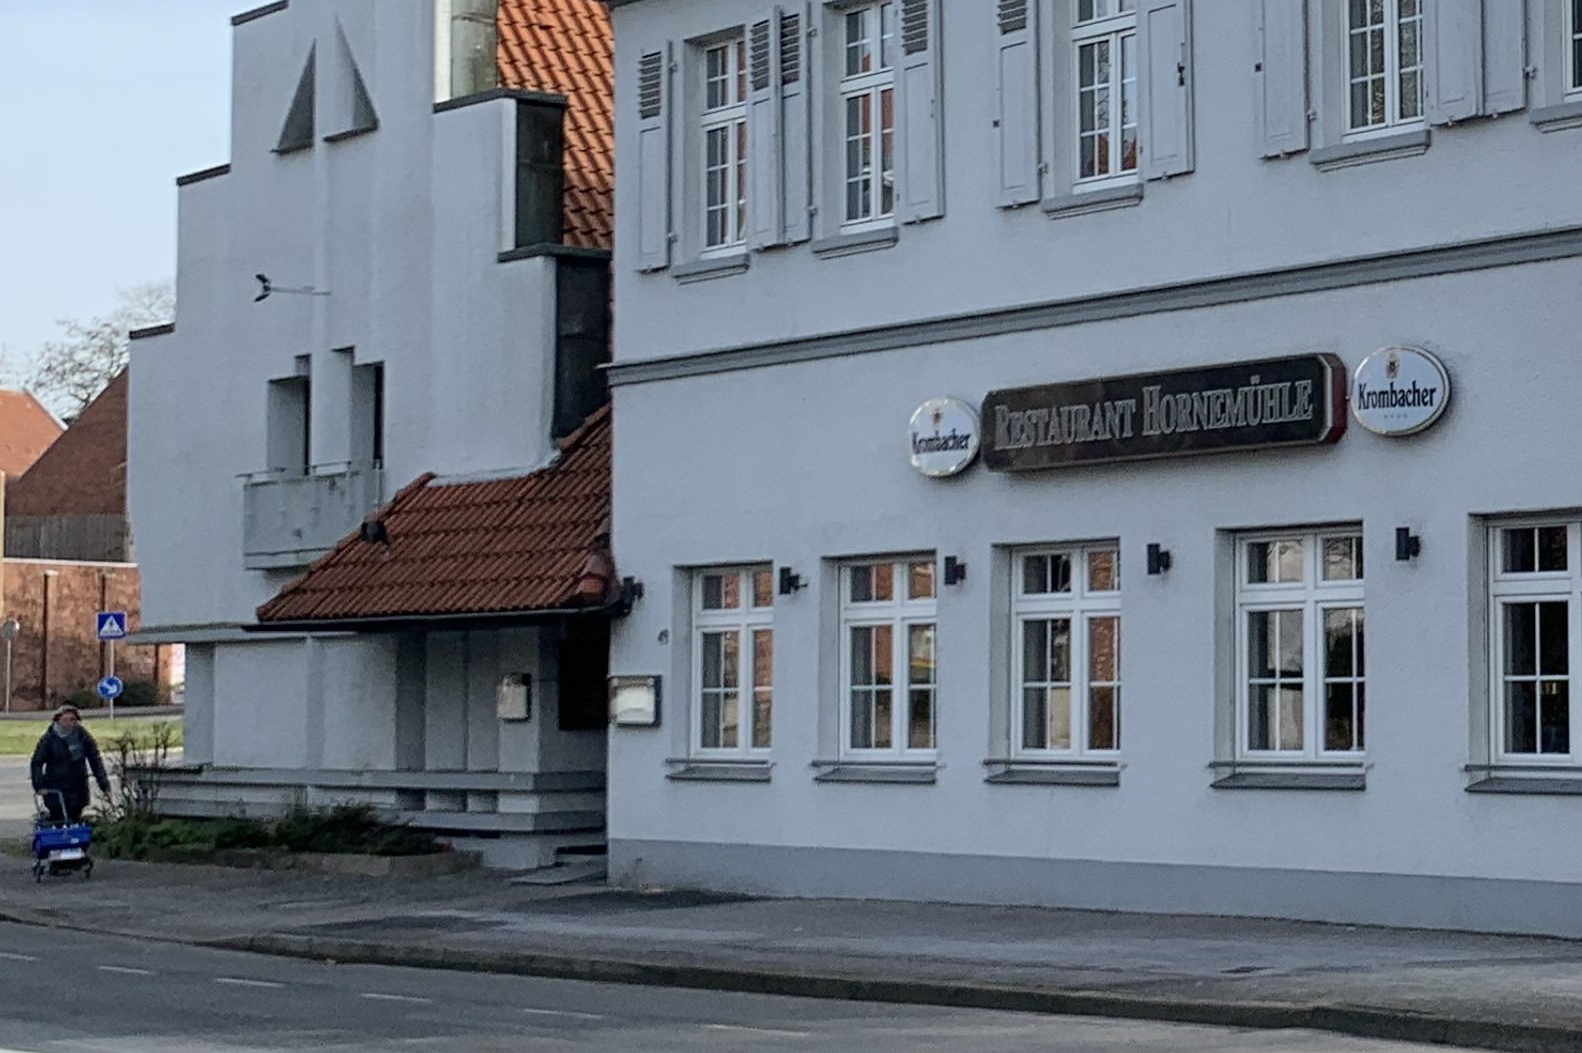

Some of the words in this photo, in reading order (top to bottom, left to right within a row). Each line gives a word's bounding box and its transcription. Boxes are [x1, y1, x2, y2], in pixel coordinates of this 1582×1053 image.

[994, 399, 1136, 450] RESTAURANT
[1142, 374, 1313, 436] HORNEMÜHLE
[1358, 379, 1437, 410] Krombacher
